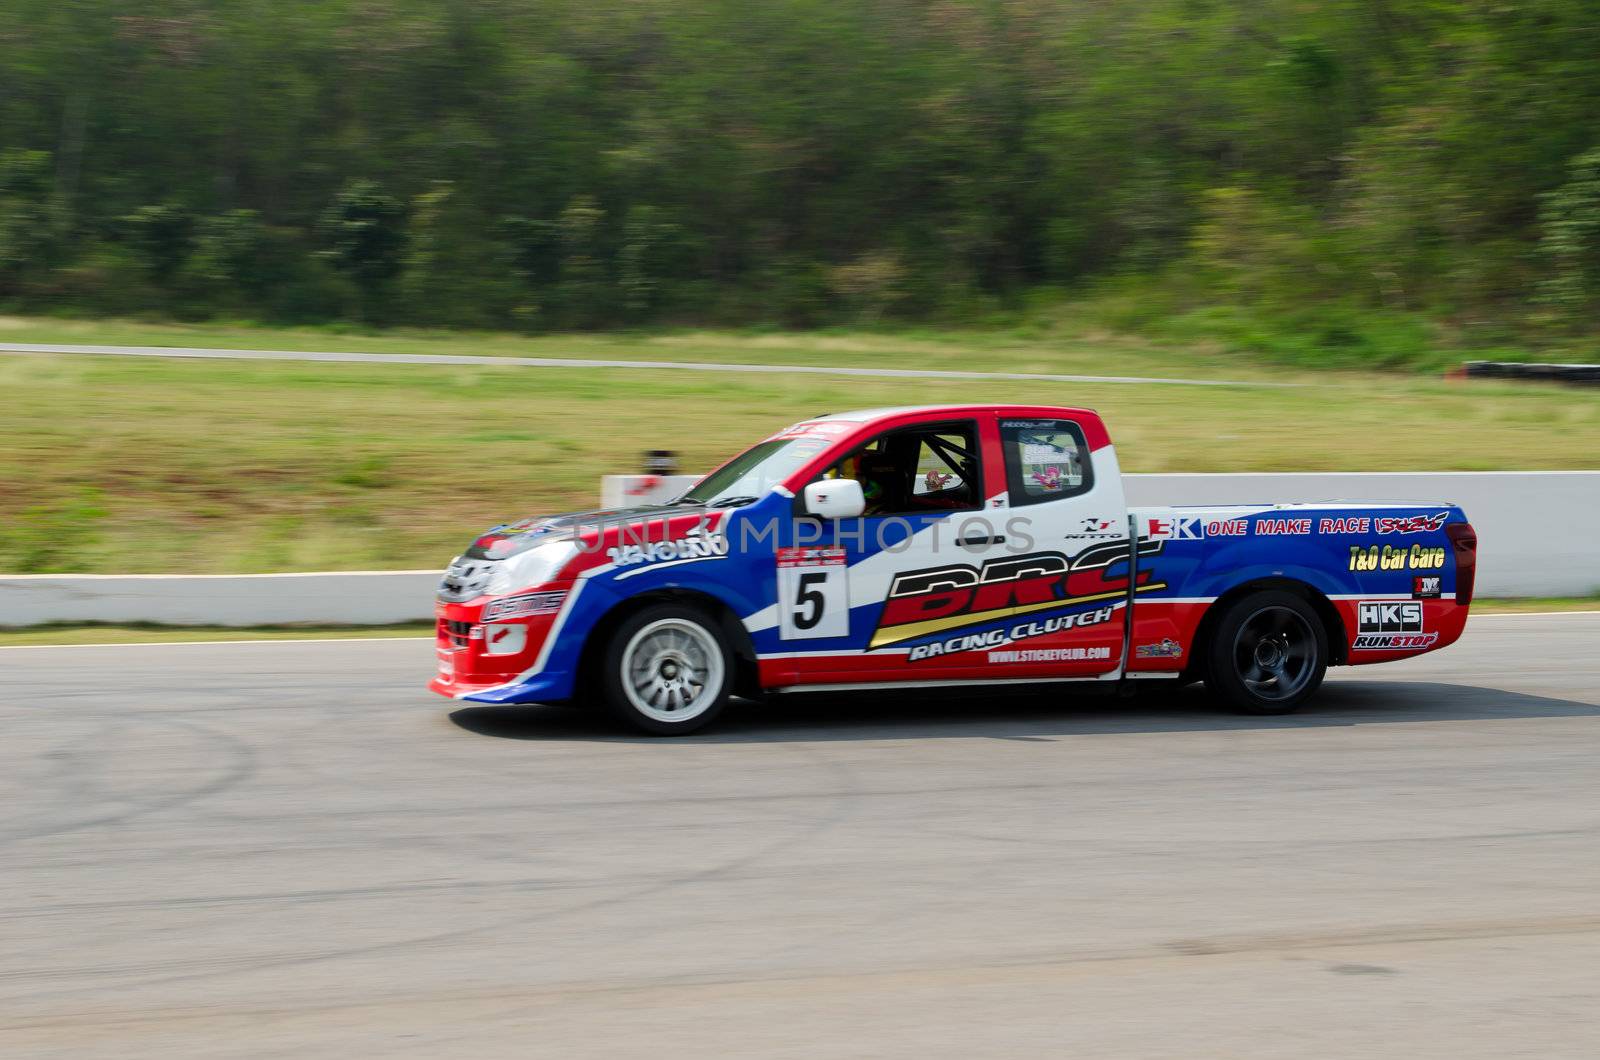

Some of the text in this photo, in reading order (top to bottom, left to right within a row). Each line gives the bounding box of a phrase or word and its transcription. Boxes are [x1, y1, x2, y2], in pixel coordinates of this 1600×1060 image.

[1207, 520, 1248, 535] ONE
[1254, 519, 1311, 535] MAKE
[1318, 518, 1370, 534] RACE
[1375, 512, 1448, 534] ISUZU
[1349, 543, 1445, 571] T&O Car Care
[793, 572, 827, 630] 5
[1360, 605, 1420, 624] HKS
[909, 607, 1113, 661] RACING CLUTCH
[1353, 633, 1439, 649] RUNSTOP
